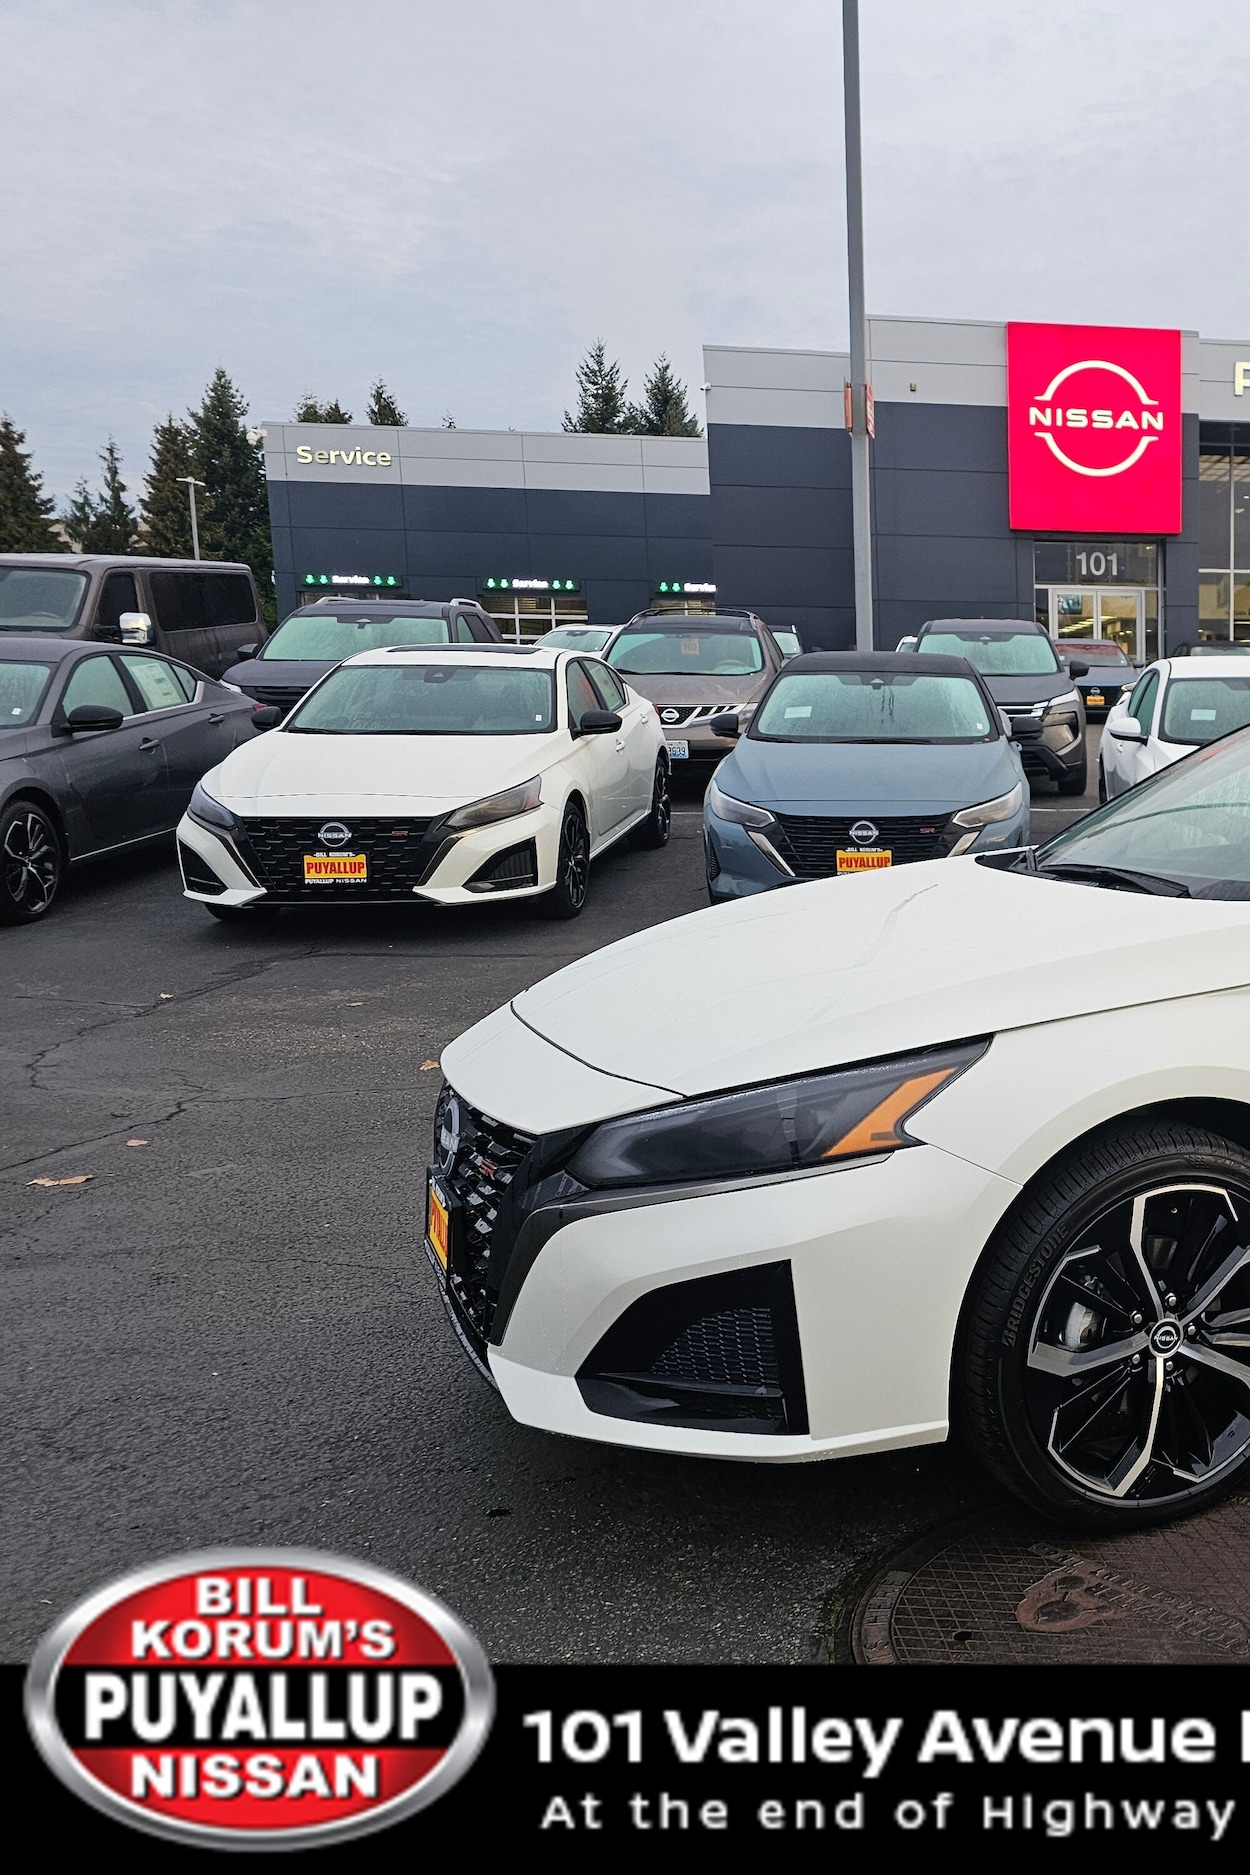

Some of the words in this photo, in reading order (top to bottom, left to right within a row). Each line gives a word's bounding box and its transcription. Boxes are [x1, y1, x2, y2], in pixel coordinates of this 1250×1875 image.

[1029, 407, 1164, 430] NISSAN
[296, 445, 392, 466] Service
[1076, 551, 1118, 576] 101
[318, 831, 353, 839] NISSAN
[306, 861, 365, 875] PUYALLUP
[838, 856, 891, 869] PUYALLUP
[1001, 1222, 1069, 1348] BRIDGESTONE
